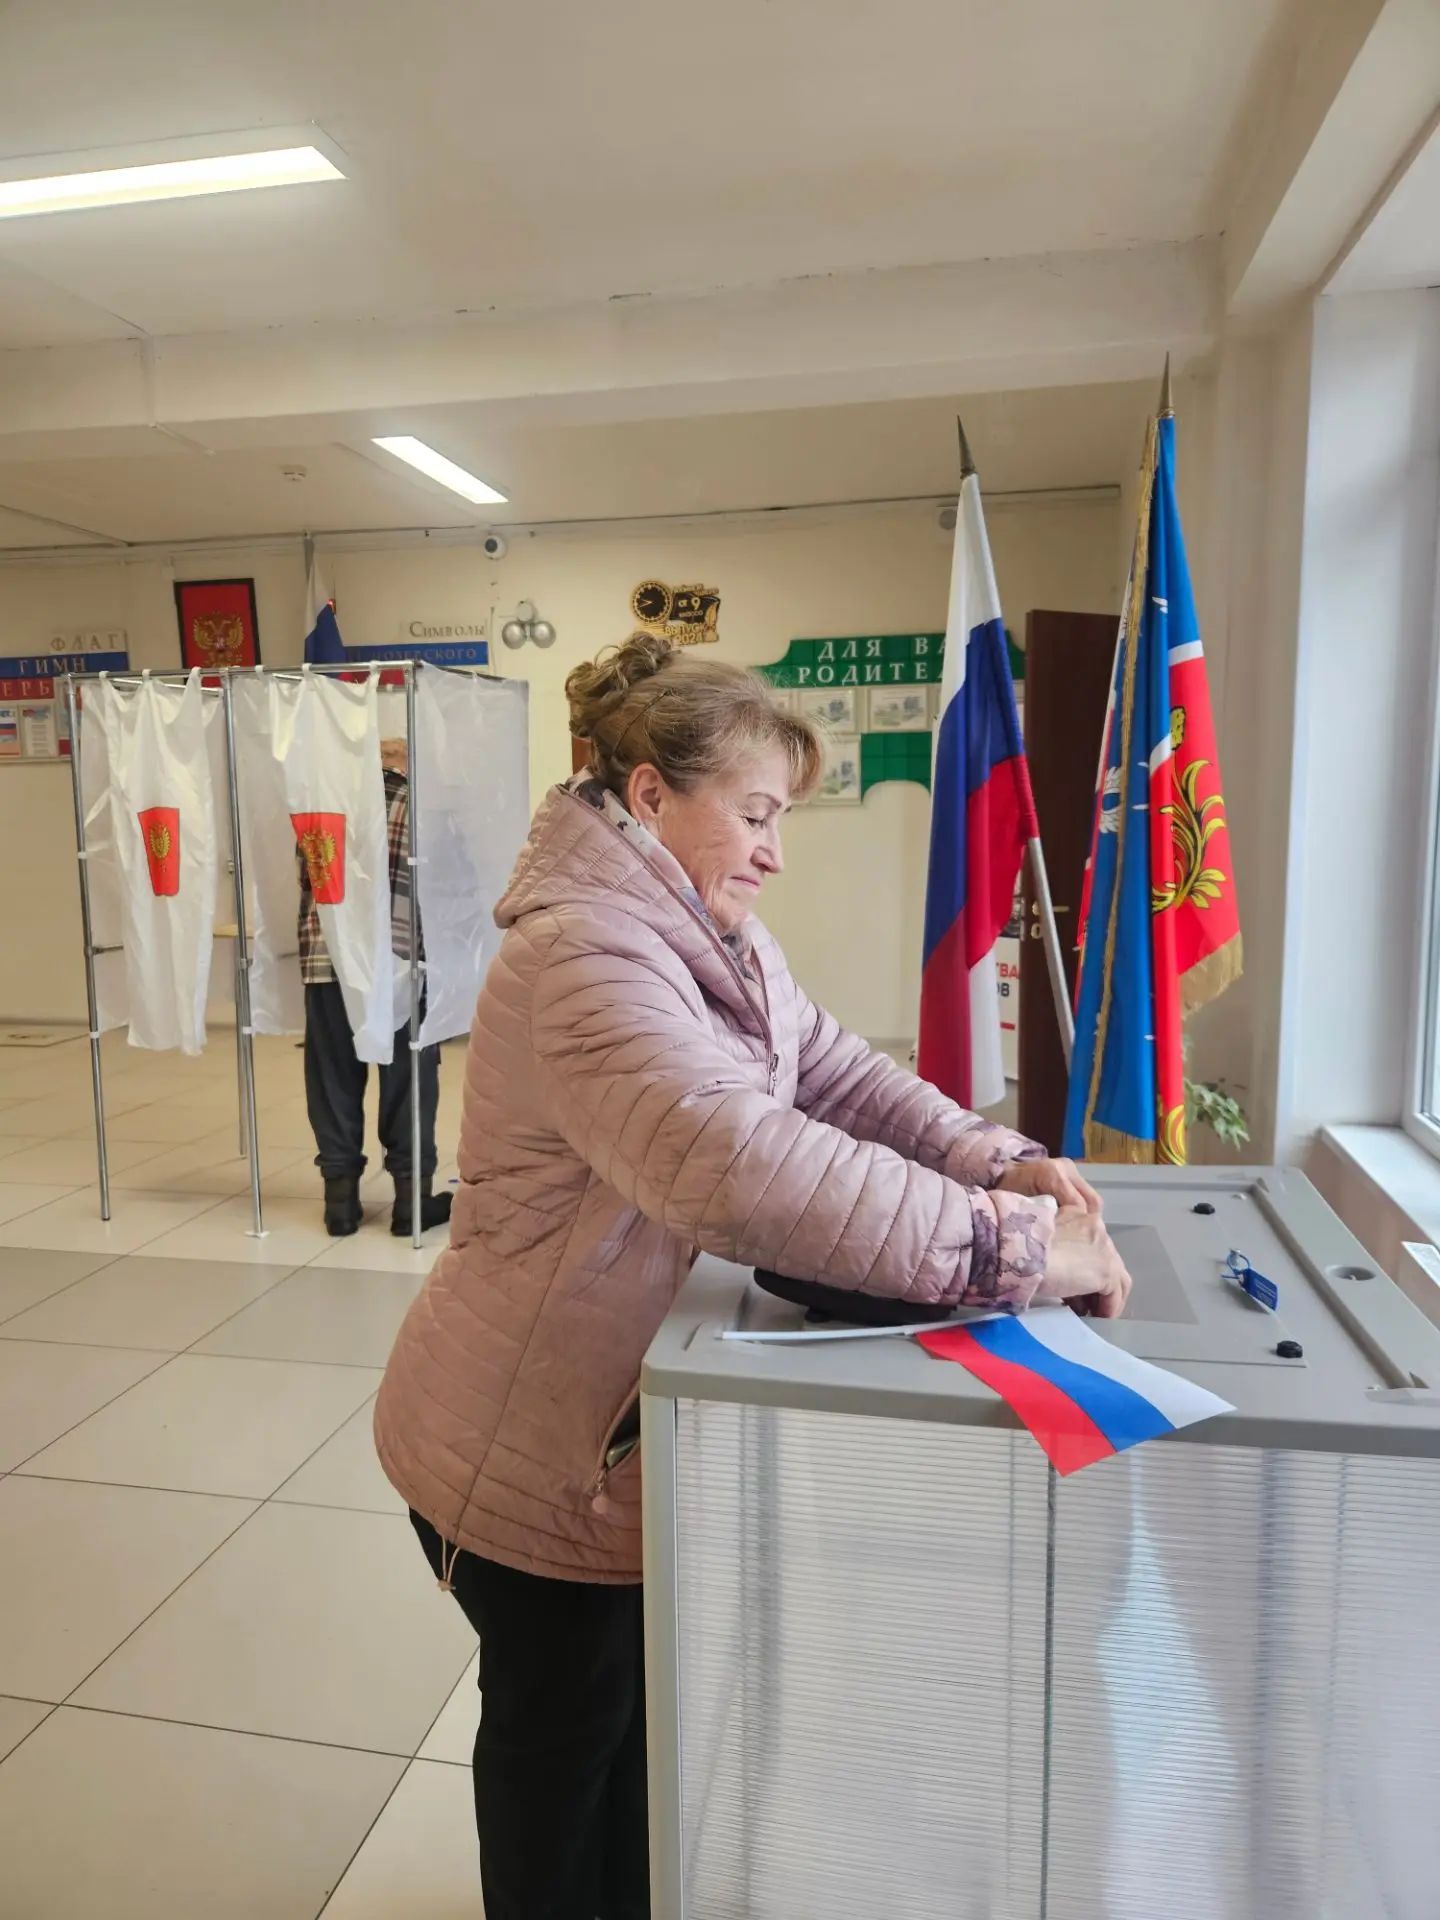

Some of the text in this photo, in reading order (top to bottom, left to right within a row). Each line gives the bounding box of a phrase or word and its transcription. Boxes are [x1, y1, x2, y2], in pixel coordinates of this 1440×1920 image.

[51, 633, 118, 651] ФЛАГ
[817, 639, 882, 662] ДЛЯ
[18, 656, 87, 675] ГИМН
[996, 963, 1020, 979] ВА
